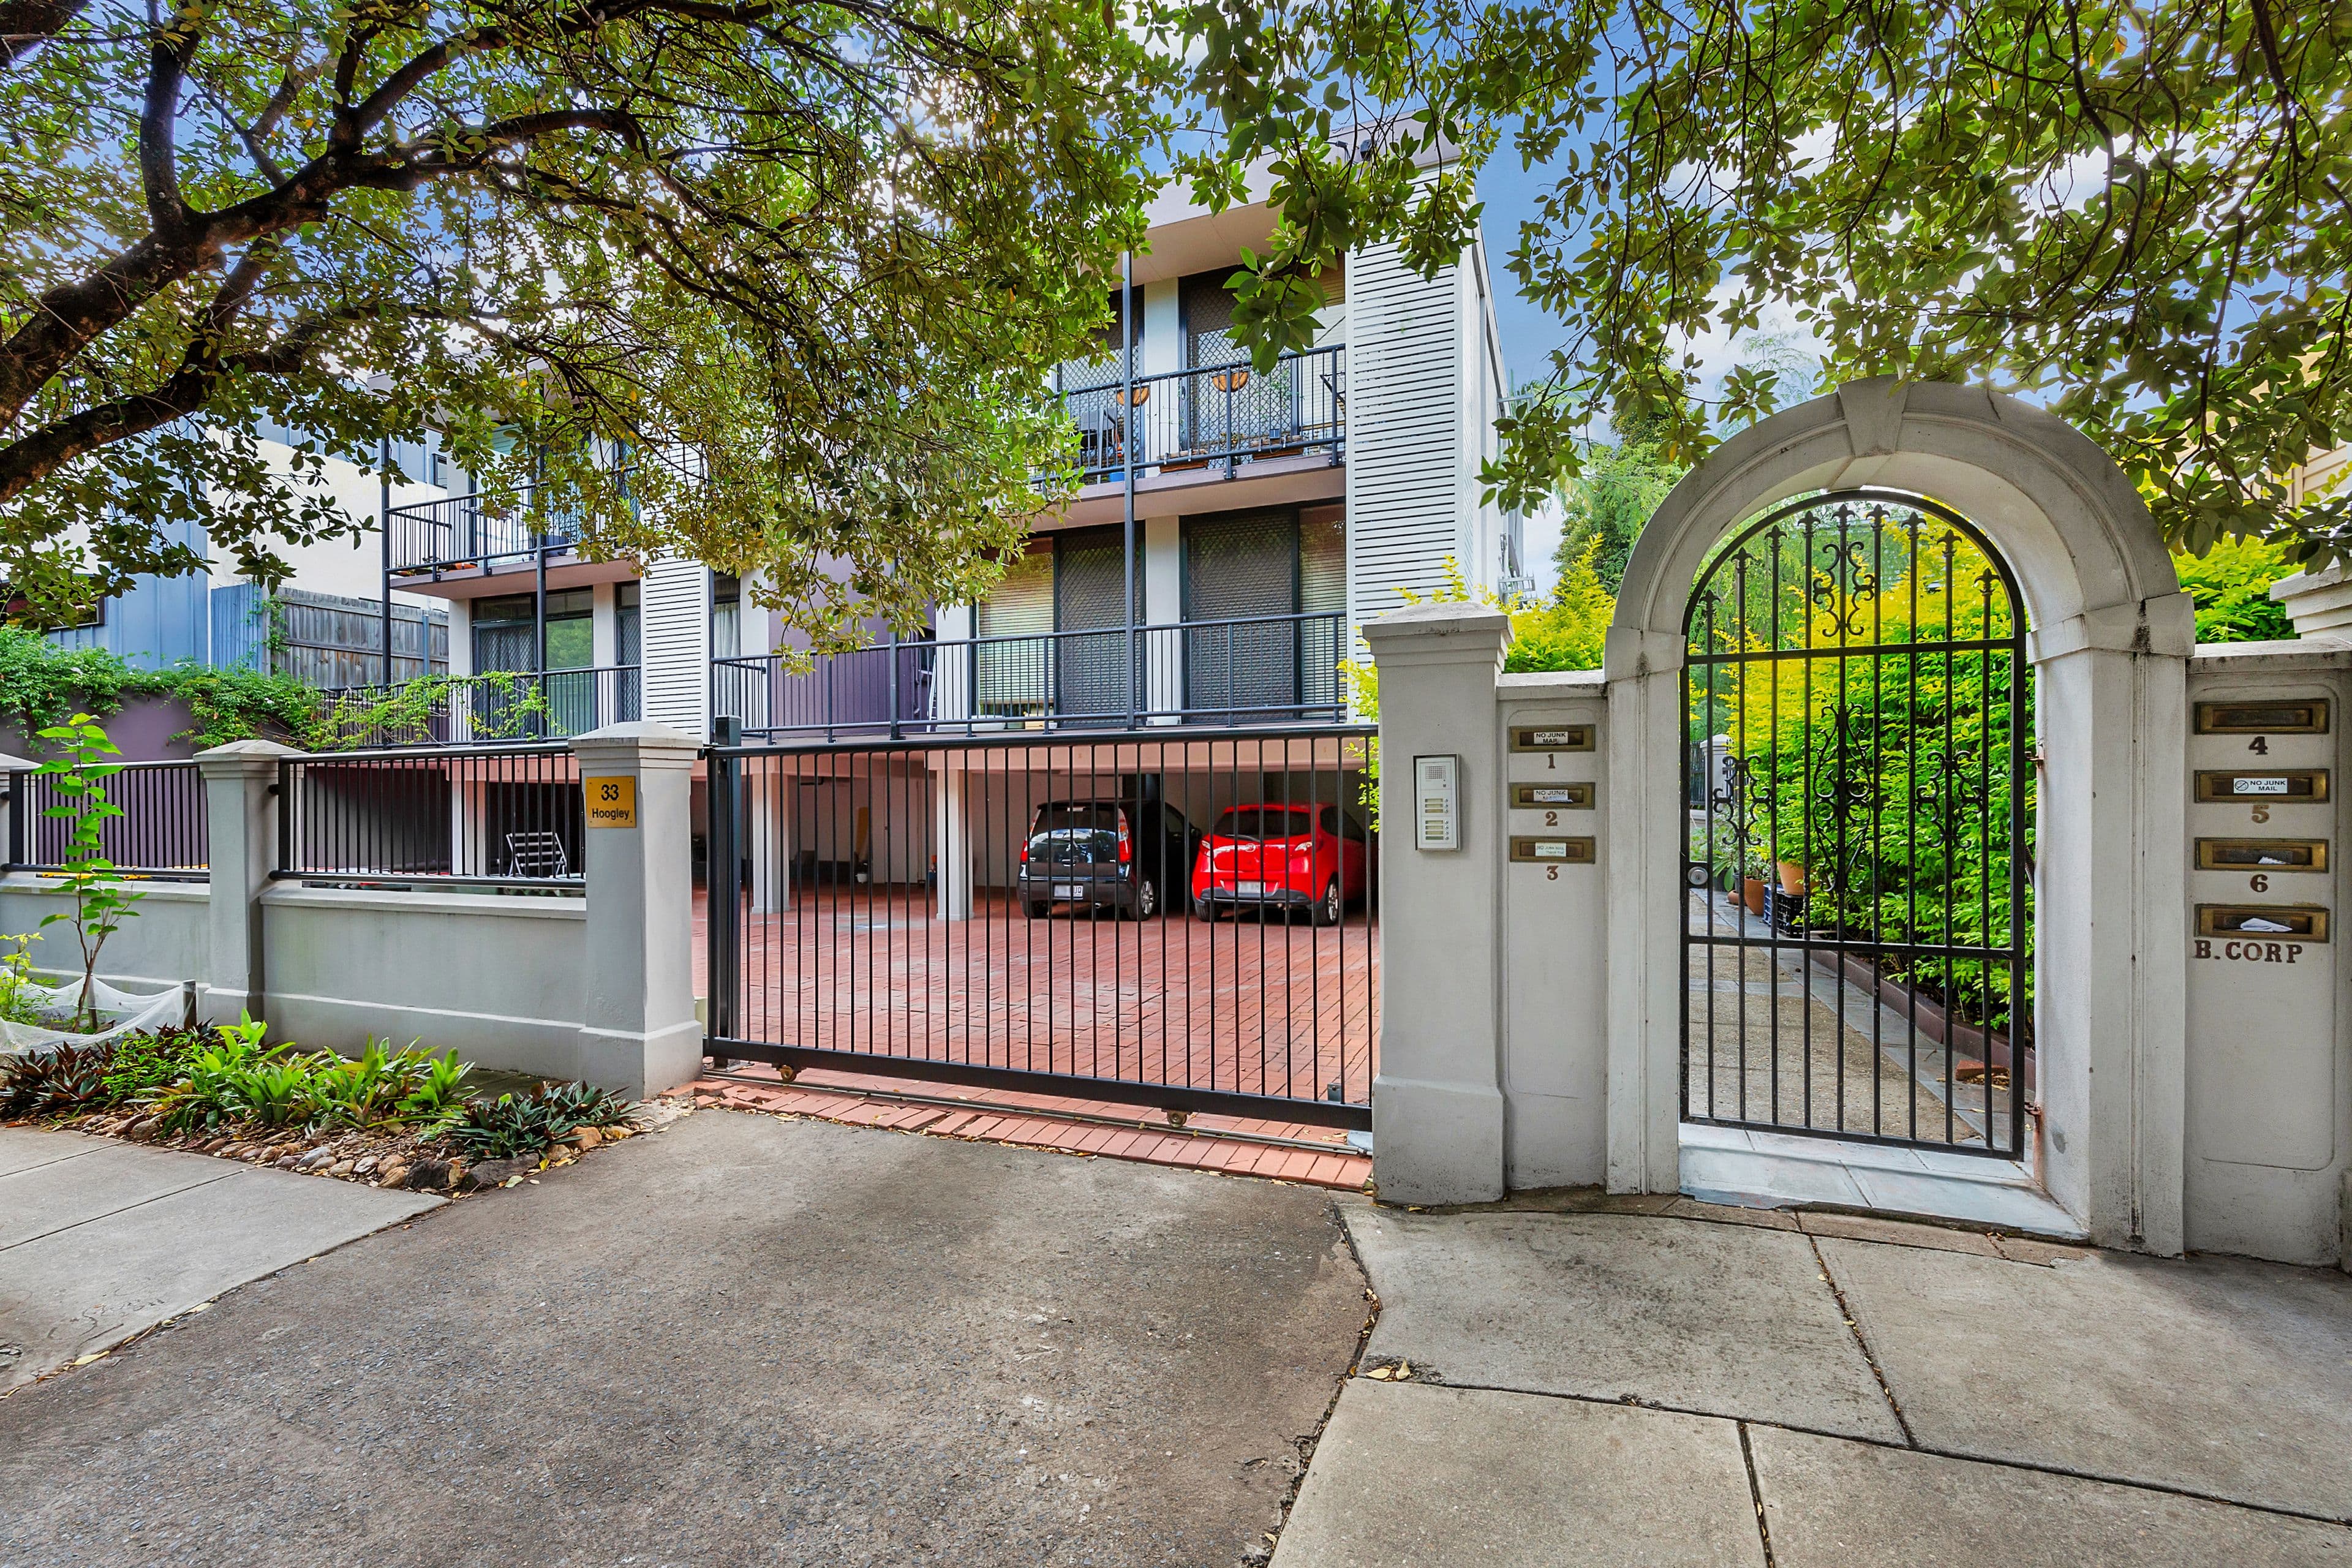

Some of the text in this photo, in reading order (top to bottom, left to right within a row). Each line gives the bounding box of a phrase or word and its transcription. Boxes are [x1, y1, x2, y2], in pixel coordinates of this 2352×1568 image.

[2248, 736, 2268, 755] 4
[1548, 753, 1556, 769] 1
[601, 784, 619, 801] 33
[592, 808, 630, 821] Hoogley
[1545, 811, 1558, 826] 2
[2251, 804, 2270, 824] 5
[1547, 865, 1559, 881] 3
[2250, 874, 2269, 893] 6
